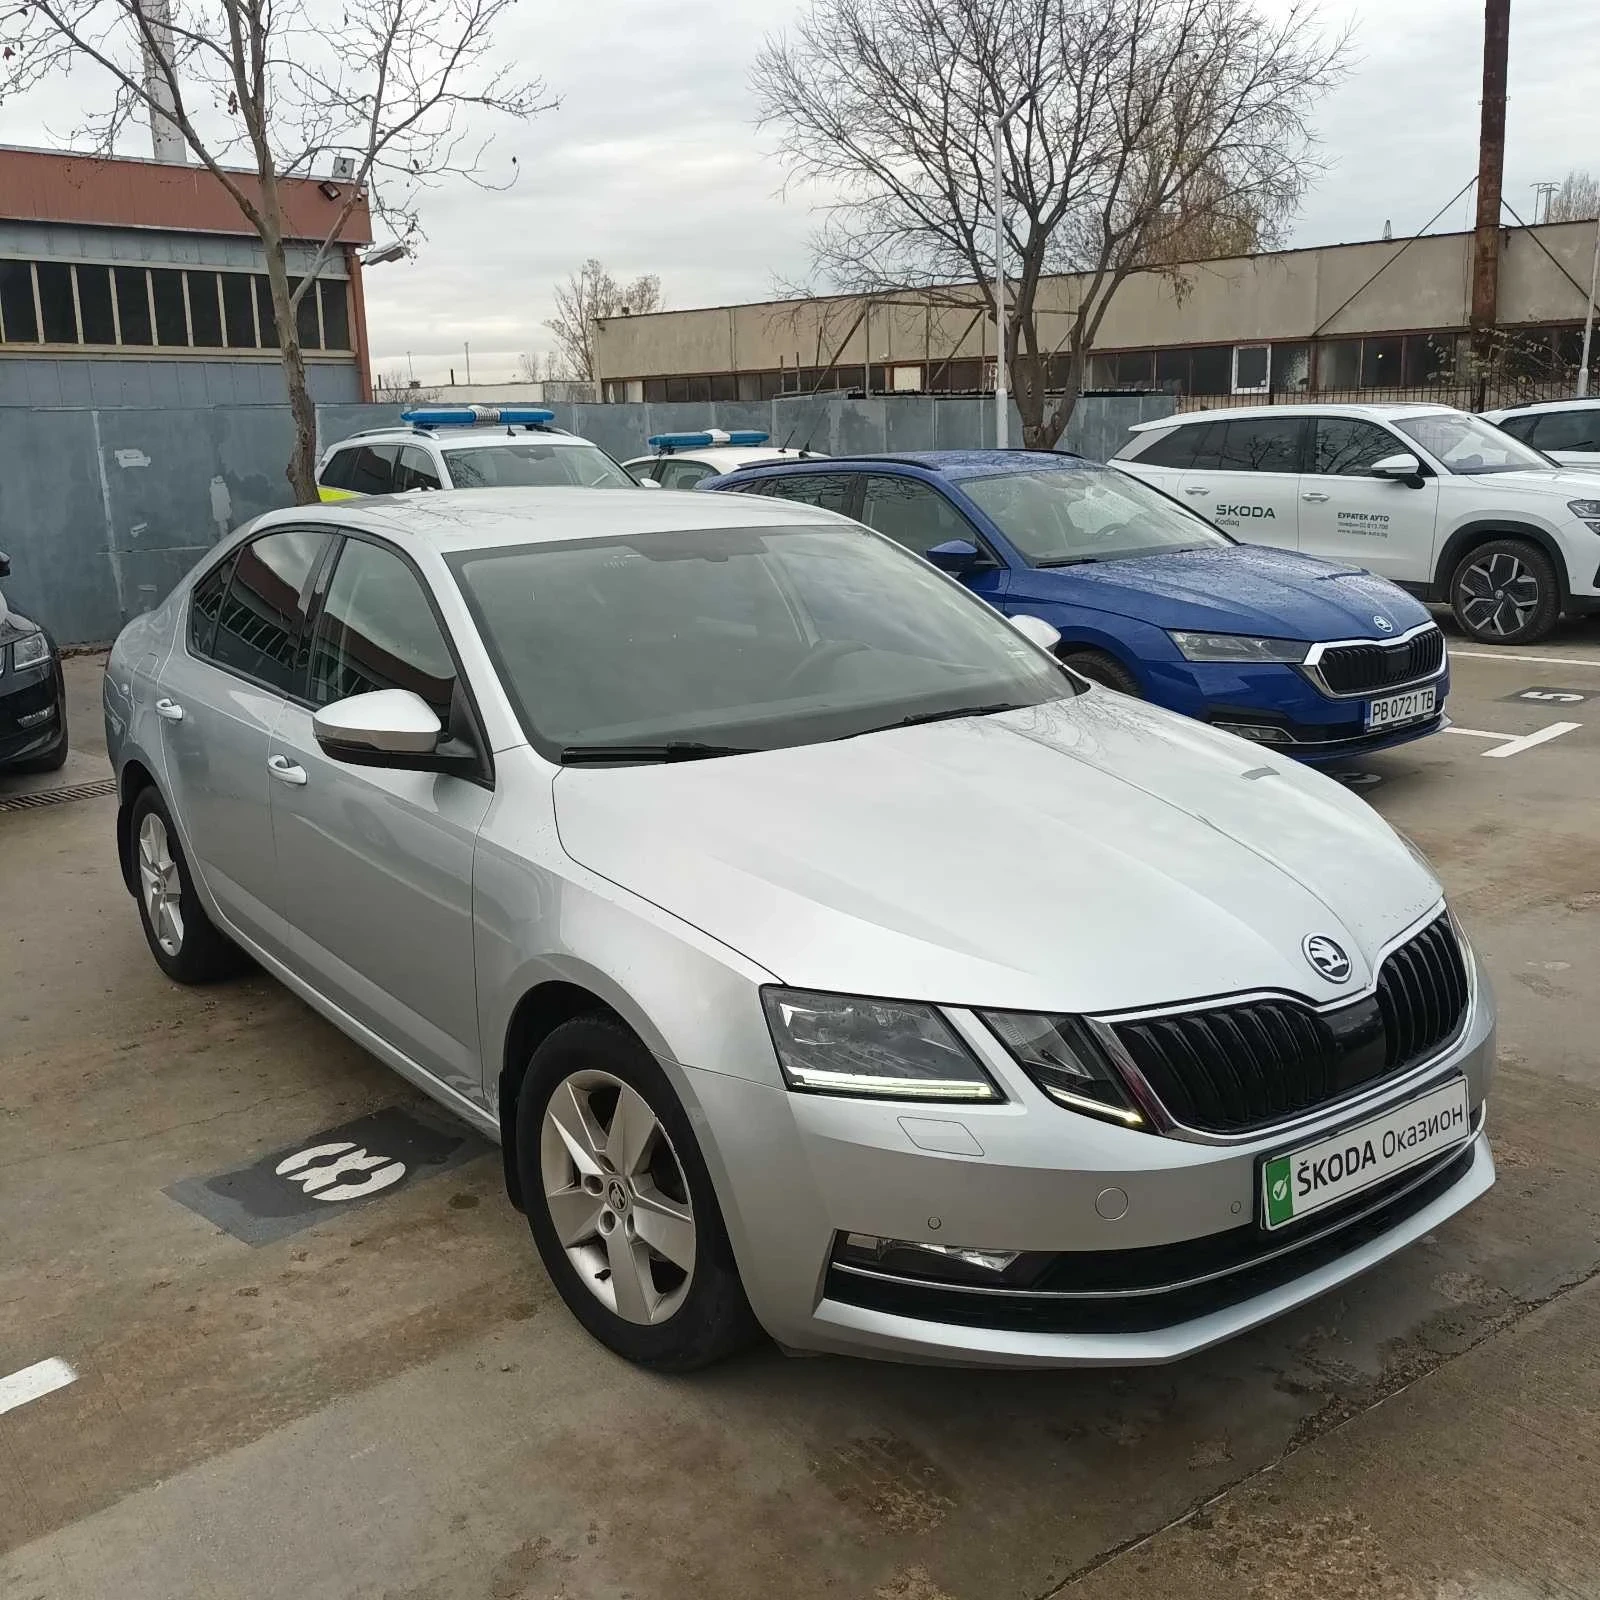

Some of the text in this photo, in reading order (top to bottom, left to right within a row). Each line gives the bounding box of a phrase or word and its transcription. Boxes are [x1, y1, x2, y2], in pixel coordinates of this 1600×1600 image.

[1373, 702, 1389, 723] PB
[1391, 694, 1418, 718] 0721
[1421, 690, 1434, 711] TB
[1519, 691, 1585, 702] 5
[275, 1142, 407, 1201] 8
[1297, 1104, 1464, 1197] ŠKODA Оказион
